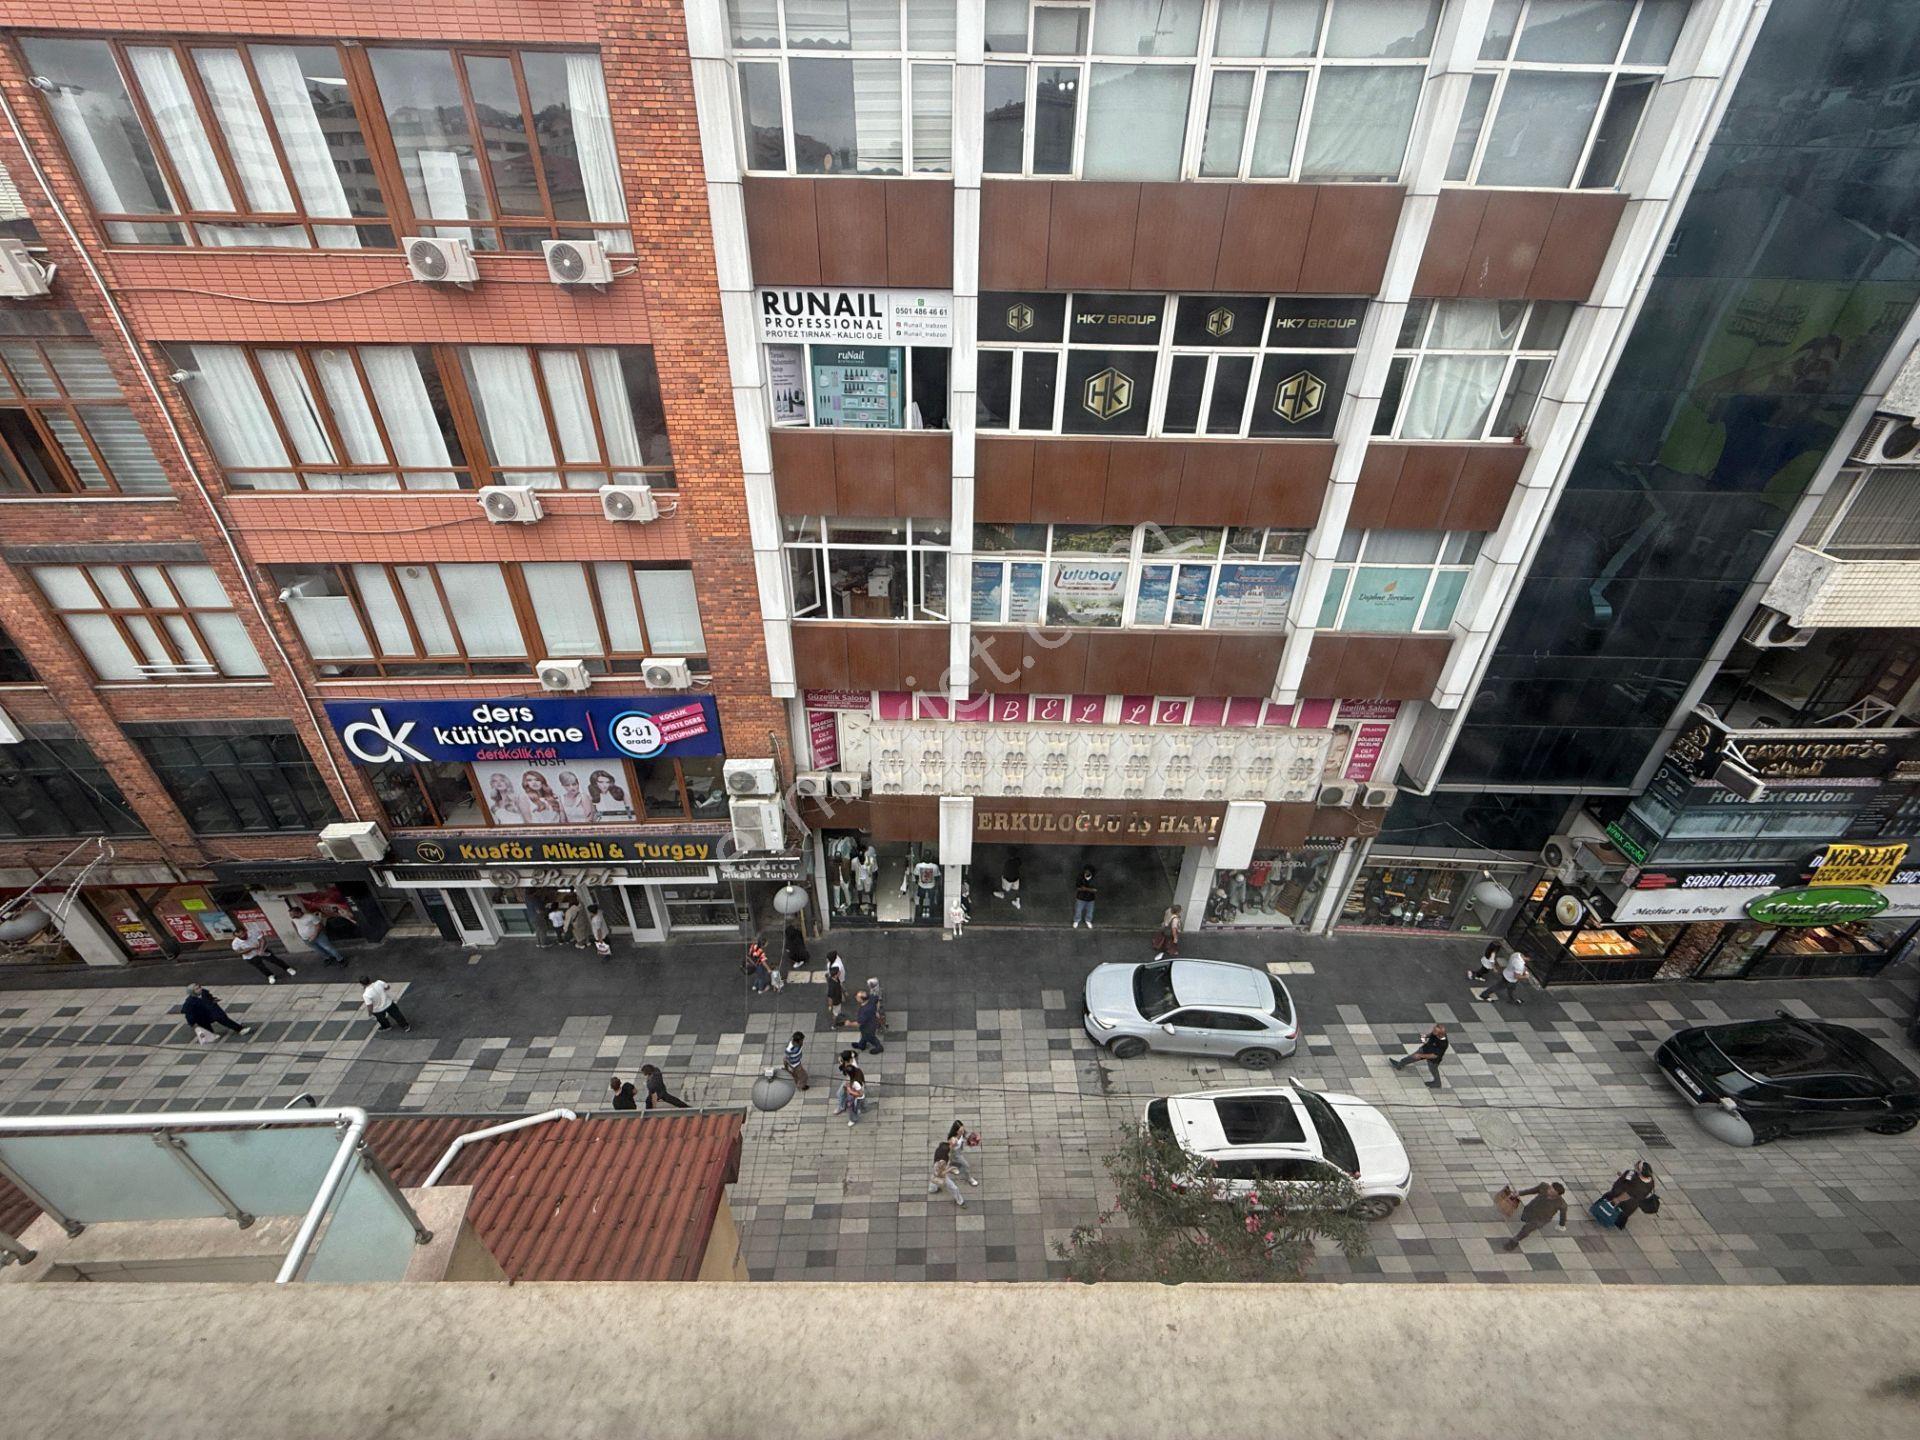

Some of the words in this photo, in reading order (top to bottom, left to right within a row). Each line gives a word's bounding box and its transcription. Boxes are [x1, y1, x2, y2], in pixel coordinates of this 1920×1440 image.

[762, 291, 882, 317] RUNAIL
[765, 317, 883, 330] PROFESSIONAL
[1076, 313, 1105, 324] HK7
[1107, 314, 1157, 324] GROUP
[1275, 318, 1306, 328] HK7
[1307, 318, 1357, 329] GROUP
[765, 330, 798, 338] PROTEZ
[837, 350, 865, 360] ruNail
[1062, 568, 1123, 583] ulubay
[808, 693, 840, 701] Güzellik
[842, 694, 870, 702] Salonu
[472, 704, 534, 723] ders
[659, 709, 688, 721] KOÇLUK
[1367, 705, 1396, 713] Salonu
[684, 717, 702, 727] DERS
[434, 726, 583, 748] kütüphane
[663, 727, 705, 741] KÜTÜPHANE
[1758, 790, 1855, 803] Extensions
[976, 810, 1119, 832] ERKULOĞLU
[459, 842, 533, 860] Kuaför
[542, 842, 603, 861] Mikail
[608, 843, 624, 859] &
[634, 842, 709, 861] Turgay
[765, 871, 799, 880] Turgay
[1723, 873, 1776, 887] BOZLAR
